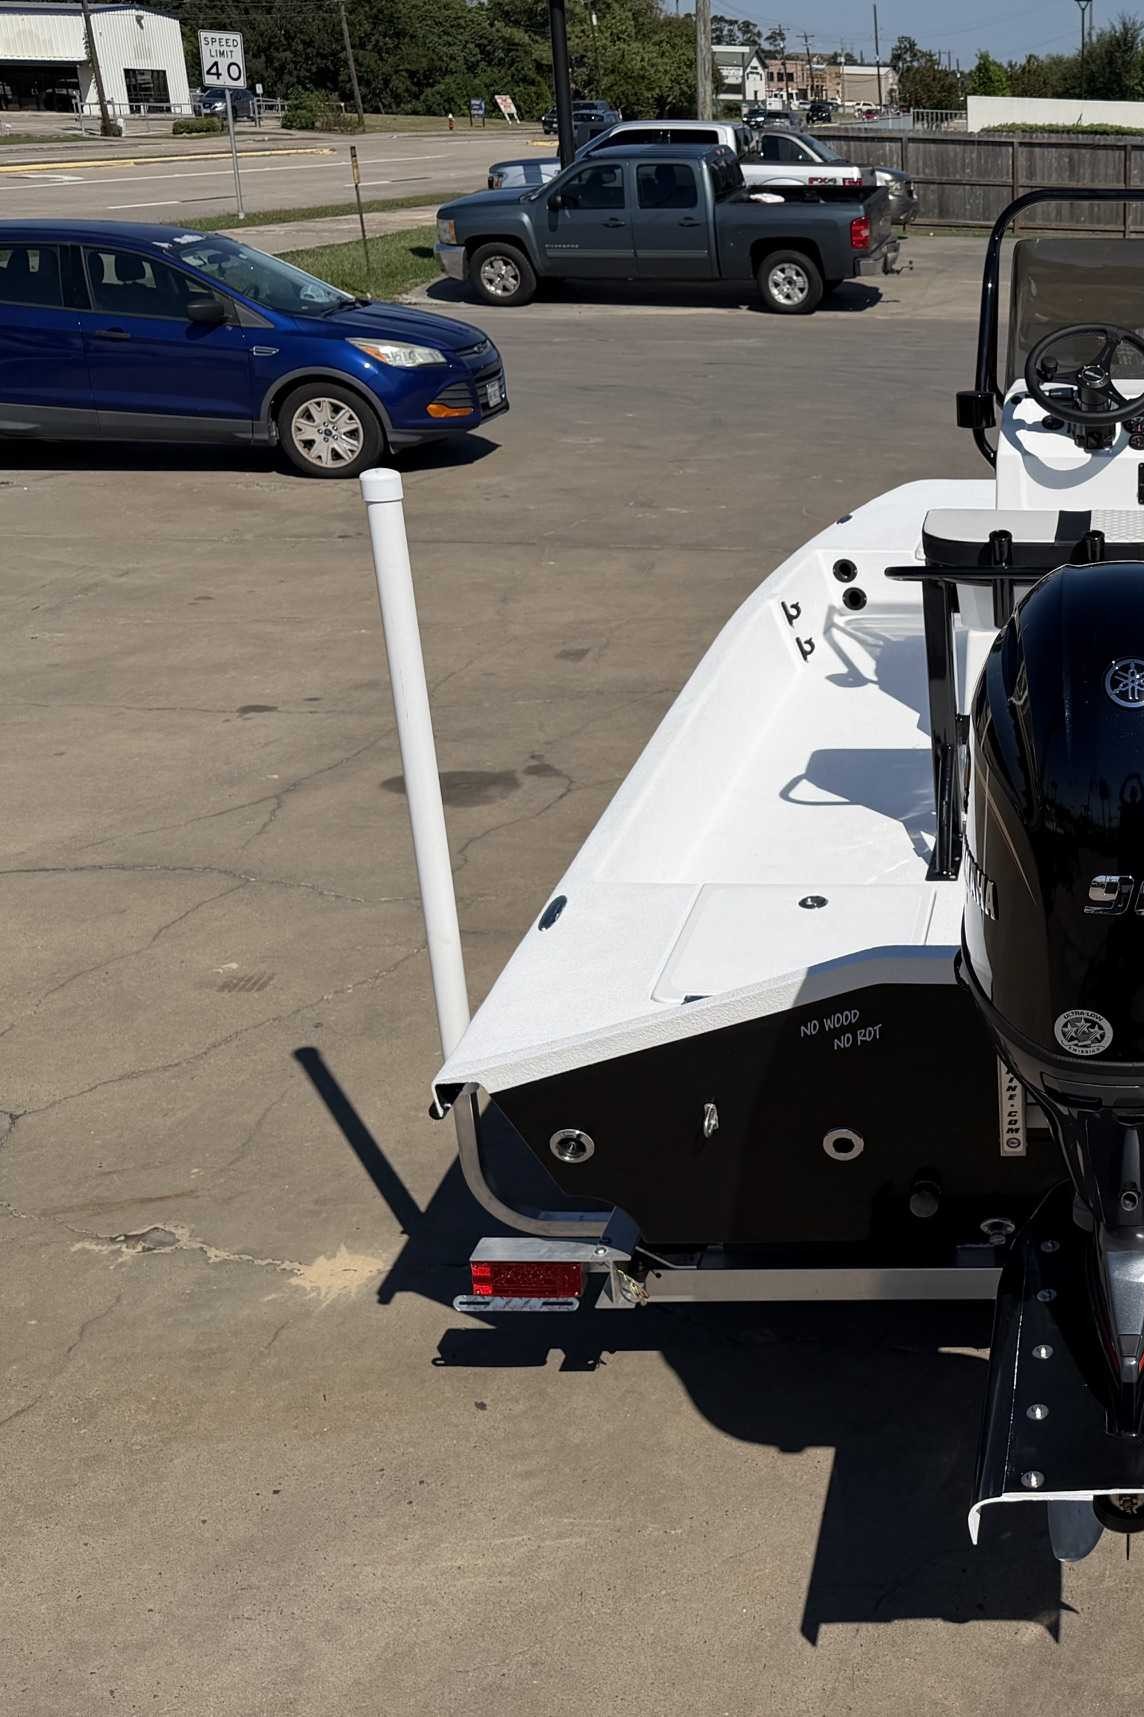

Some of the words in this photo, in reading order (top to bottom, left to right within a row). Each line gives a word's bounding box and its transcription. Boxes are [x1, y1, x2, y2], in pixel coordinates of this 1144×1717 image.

[203, 37, 239, 47] SPEED
[209, 48, 234, 59] LIMIT
[206, 61, 242, 81] 40
[800, 1019, 820, 1038] NO
[823, 1009, 860, 1032] WOOD
[833, 1033, 853, 1050] NO
[857, 1023, 883, 1046] ROT
